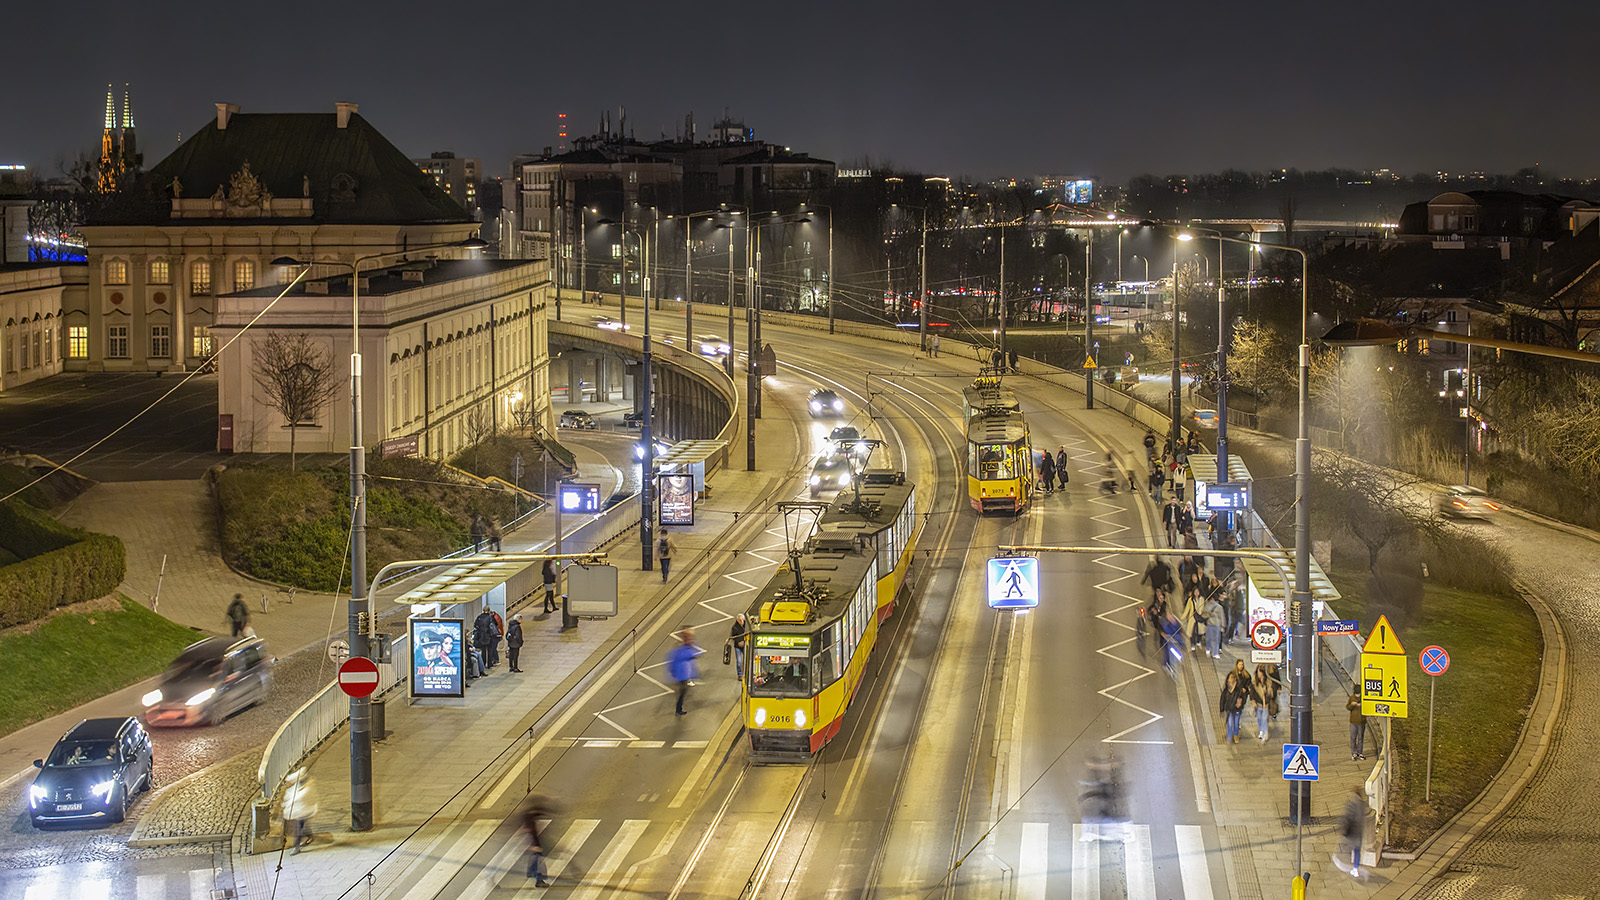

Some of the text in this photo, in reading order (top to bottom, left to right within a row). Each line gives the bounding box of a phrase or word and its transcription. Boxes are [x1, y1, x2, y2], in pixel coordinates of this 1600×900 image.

[1340, 624, 1354, 632] Zjazd
[756, 636, 768, 646] 20
[1366, 681, 1382, 690] BUS
